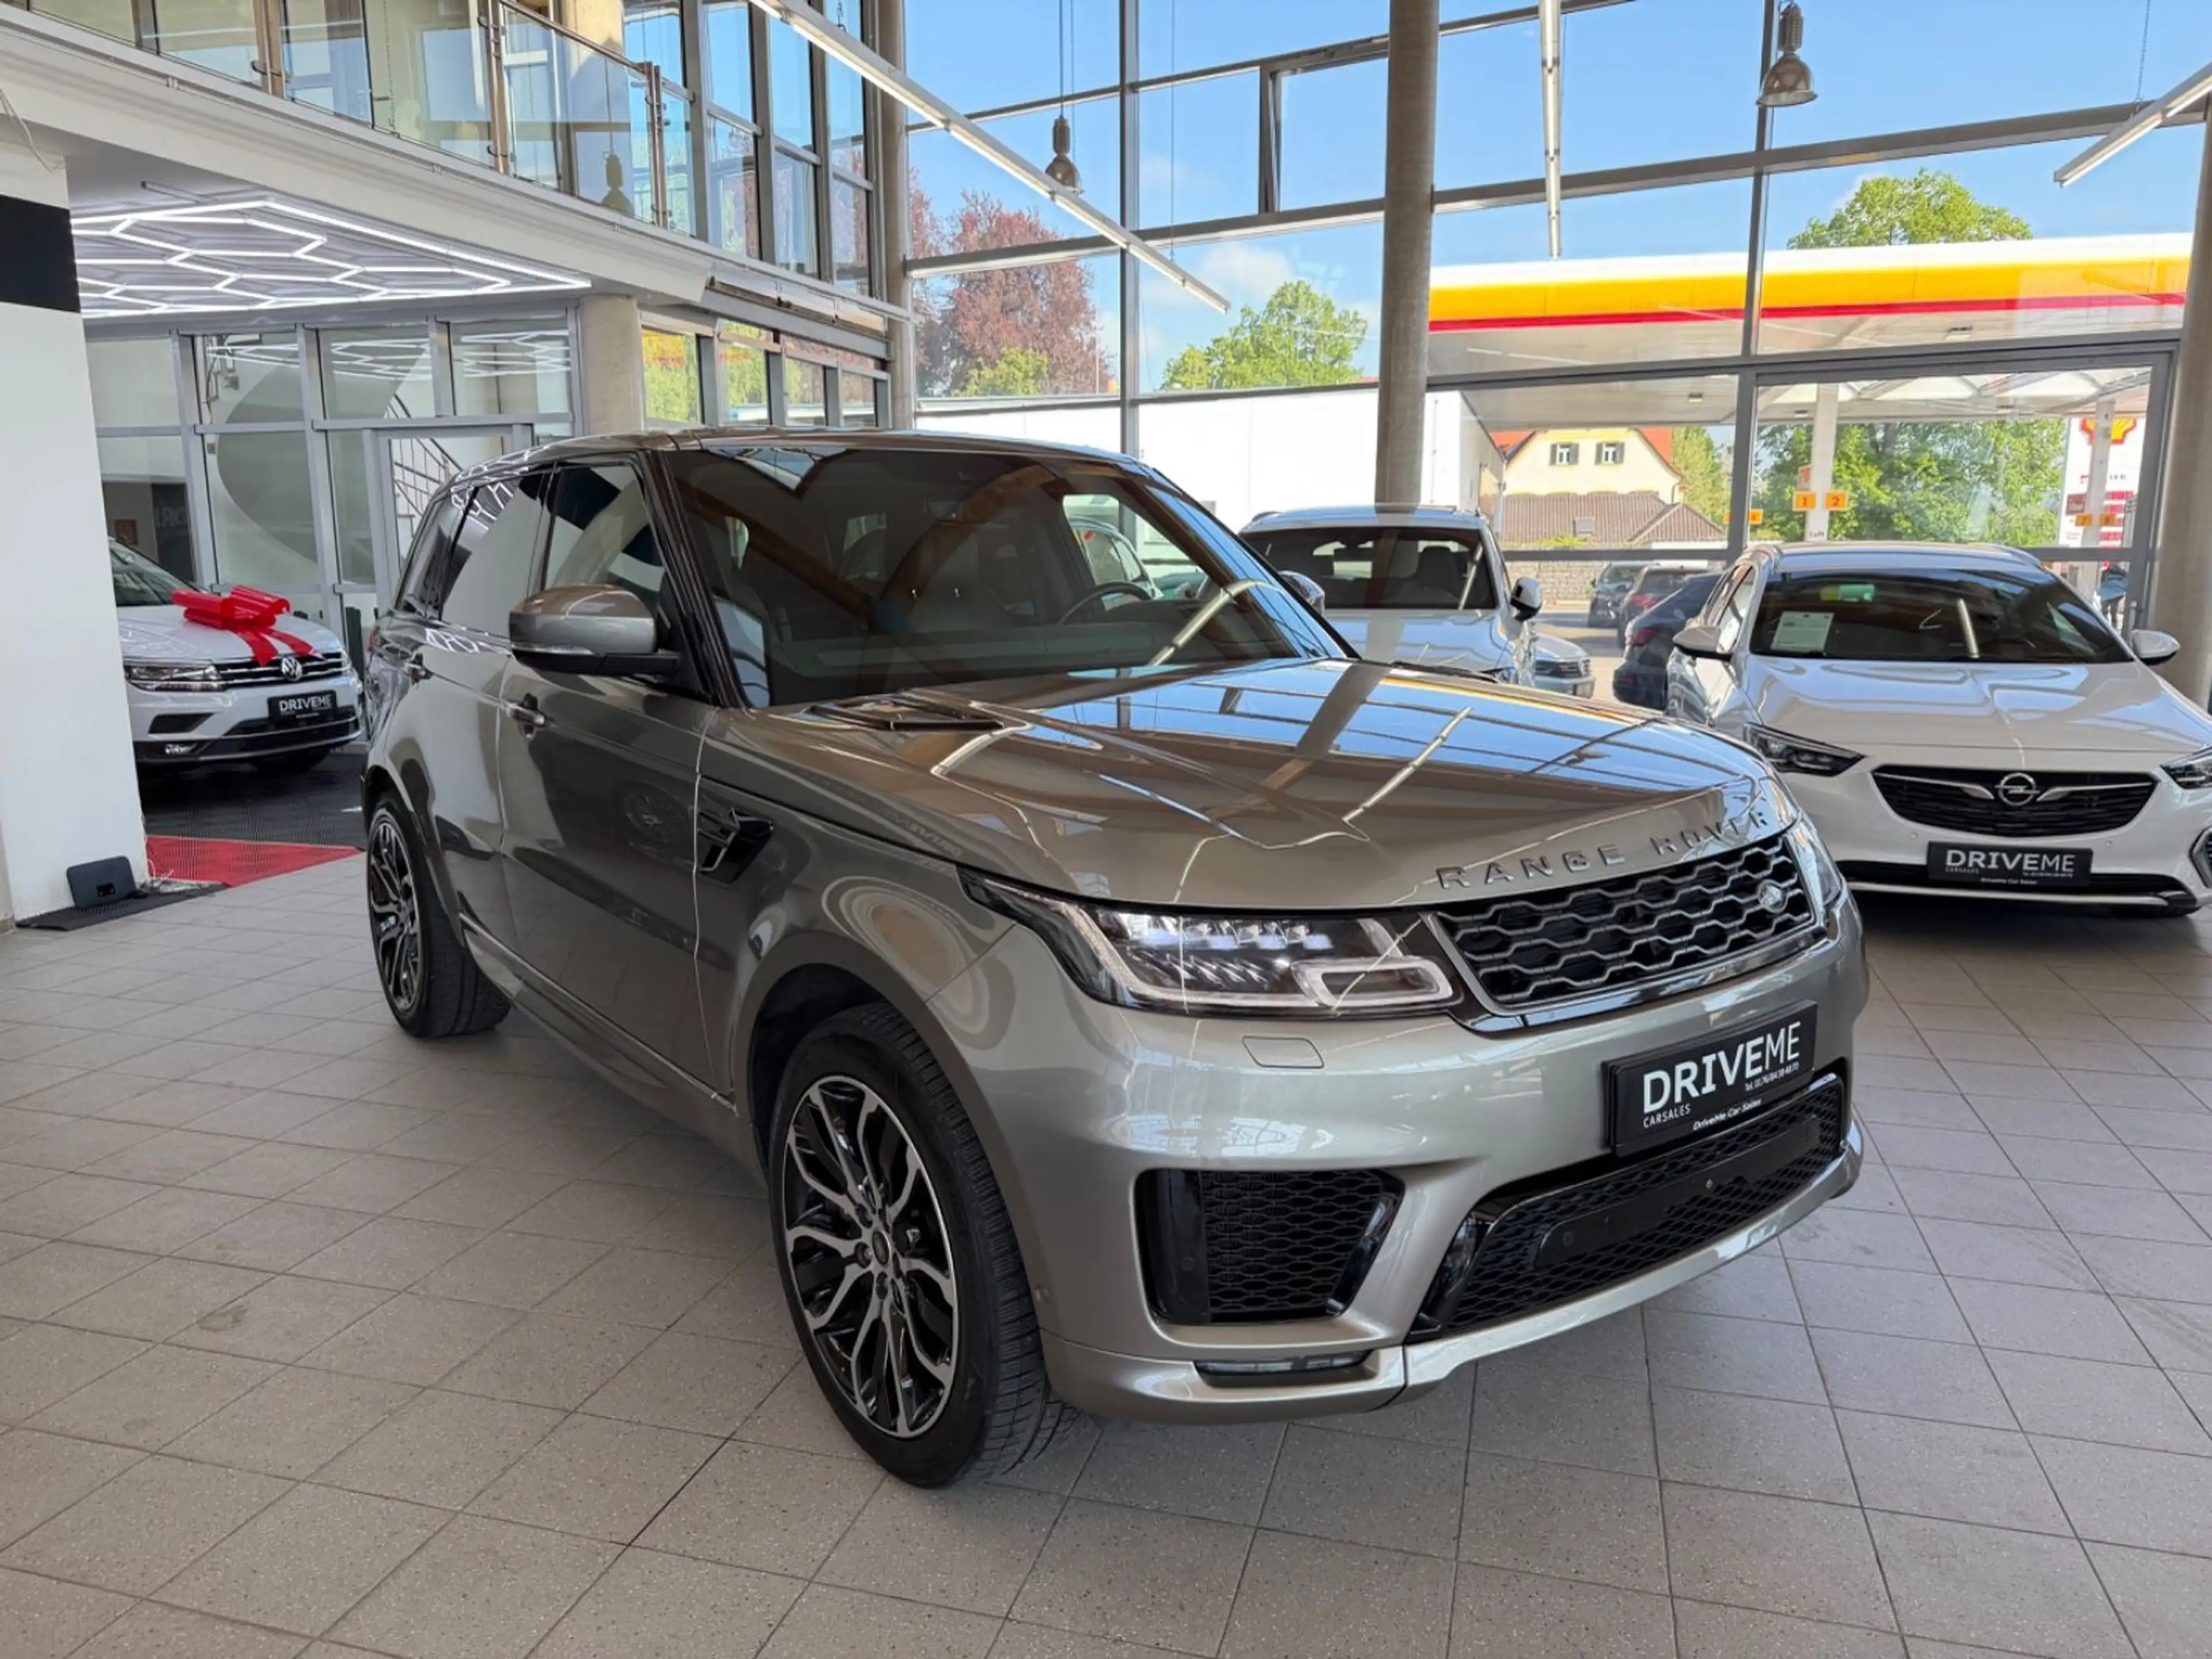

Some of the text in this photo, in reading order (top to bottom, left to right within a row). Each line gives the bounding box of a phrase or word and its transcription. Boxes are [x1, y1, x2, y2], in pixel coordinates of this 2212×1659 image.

[1831, 496, 1840, 506] 2
[1436, 809, 1769, 890] RANGE ROVER
[1945, 849, 2075, 873] DRIVEME
[1643, 1021, 1801, 1114] DRIVEME
[1643, 1103, 1691, 1129] CARSALES
